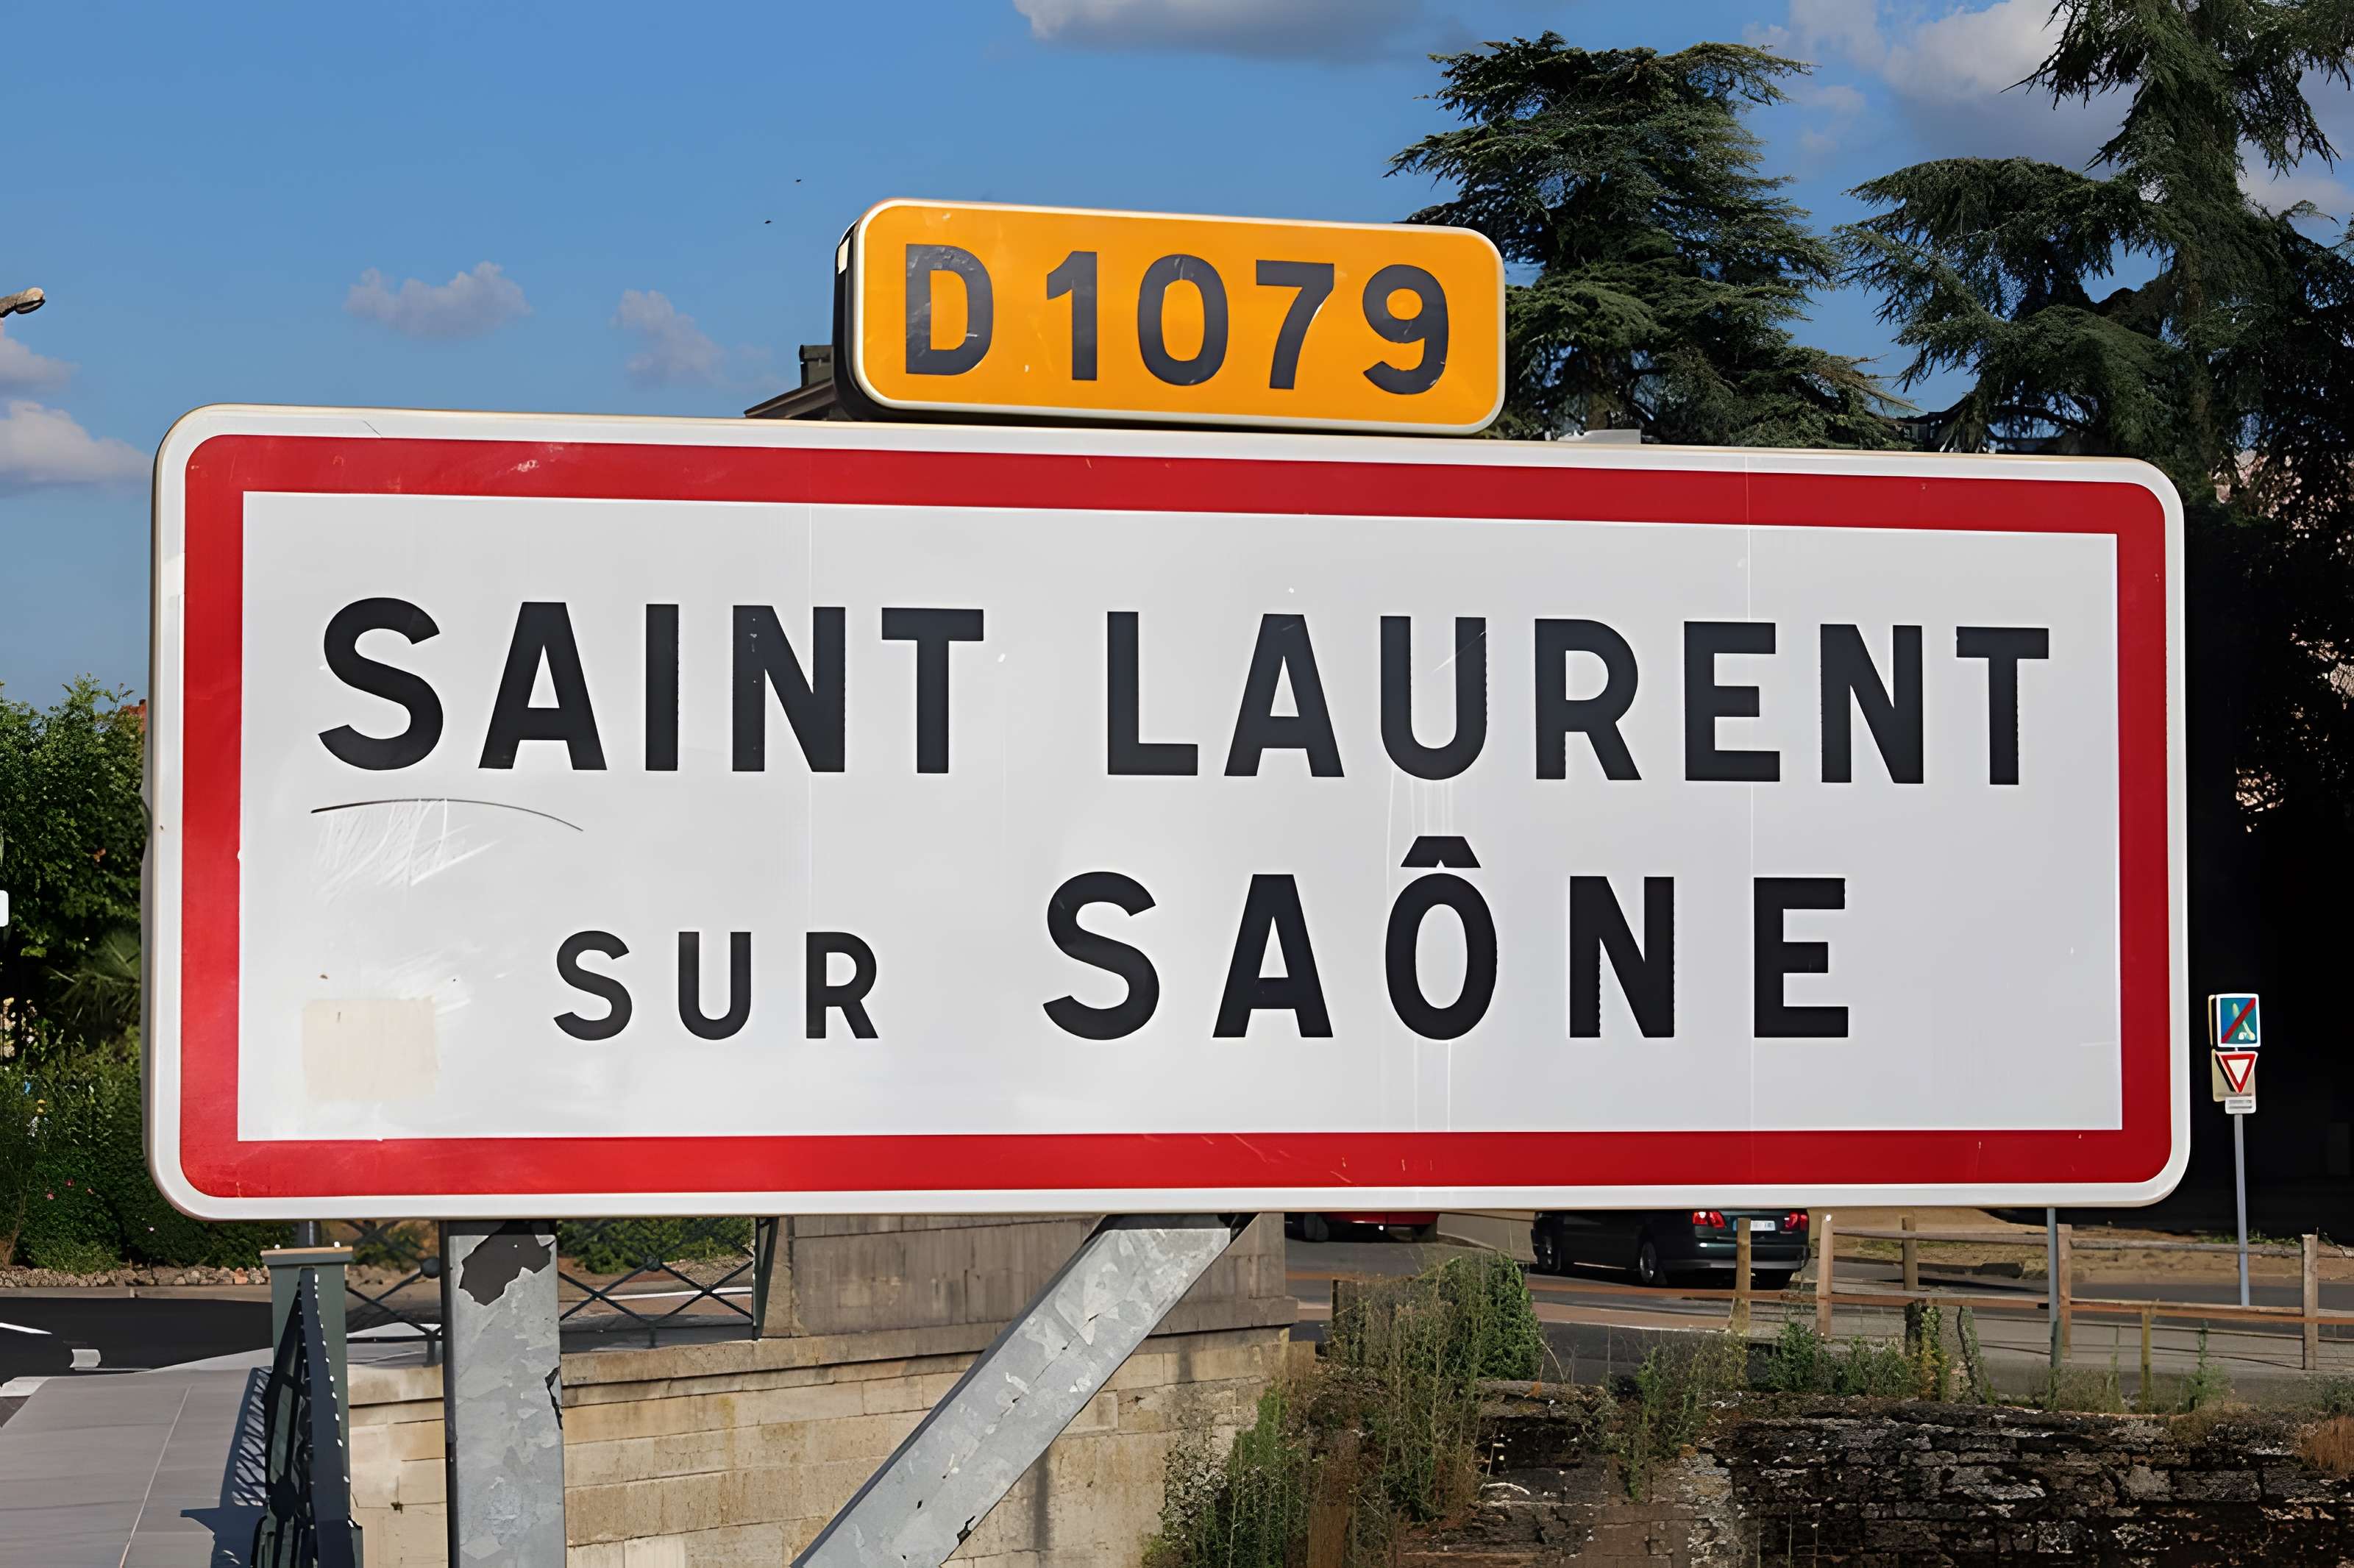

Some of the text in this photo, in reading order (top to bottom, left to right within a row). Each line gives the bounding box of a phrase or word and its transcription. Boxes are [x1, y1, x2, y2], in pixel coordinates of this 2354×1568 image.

[906, 243, 1449, 395] D 1079
[317, 596, 2049, 785] SAINT LAURENT
[553, 835, 1849, 1041] SUR SAÔNE
